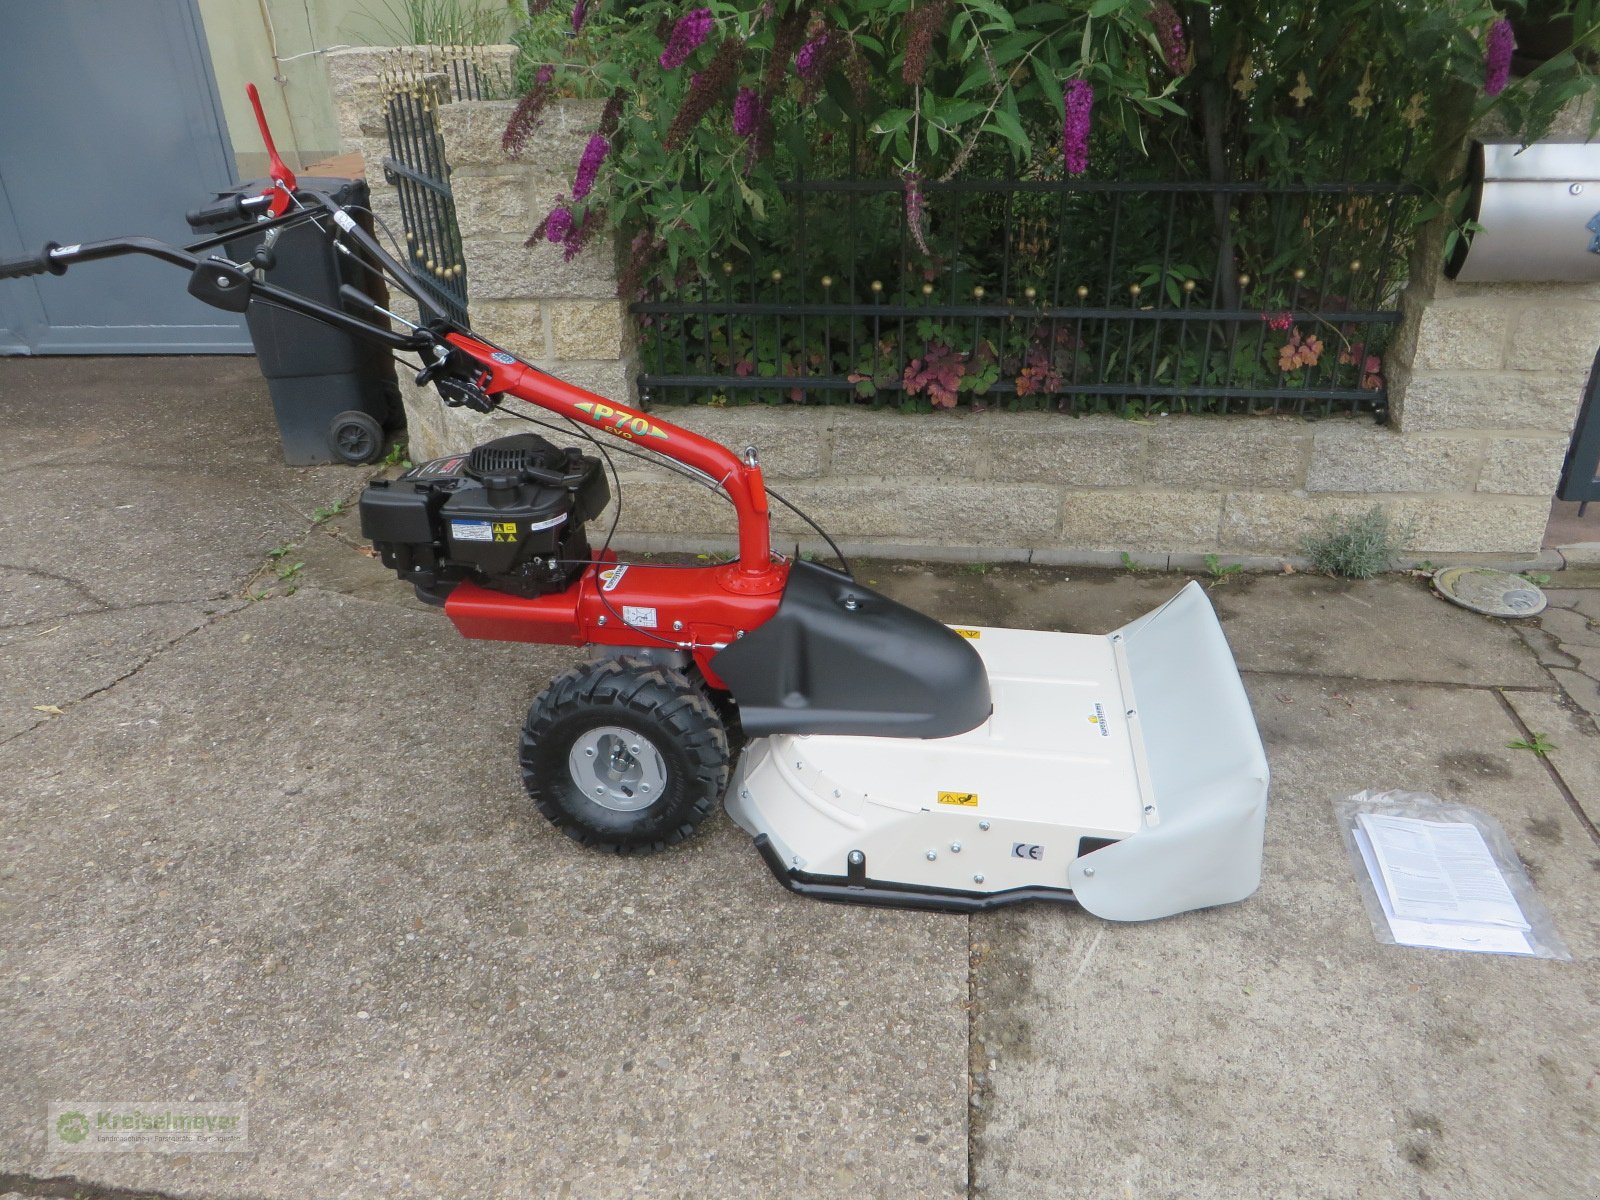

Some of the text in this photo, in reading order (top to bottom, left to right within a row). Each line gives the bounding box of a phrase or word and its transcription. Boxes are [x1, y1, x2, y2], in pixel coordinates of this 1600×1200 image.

[593, 403, 649, 436] P70
[605, 425, 633, 439] EVO
[1016, 844, 1040, 860] CE
